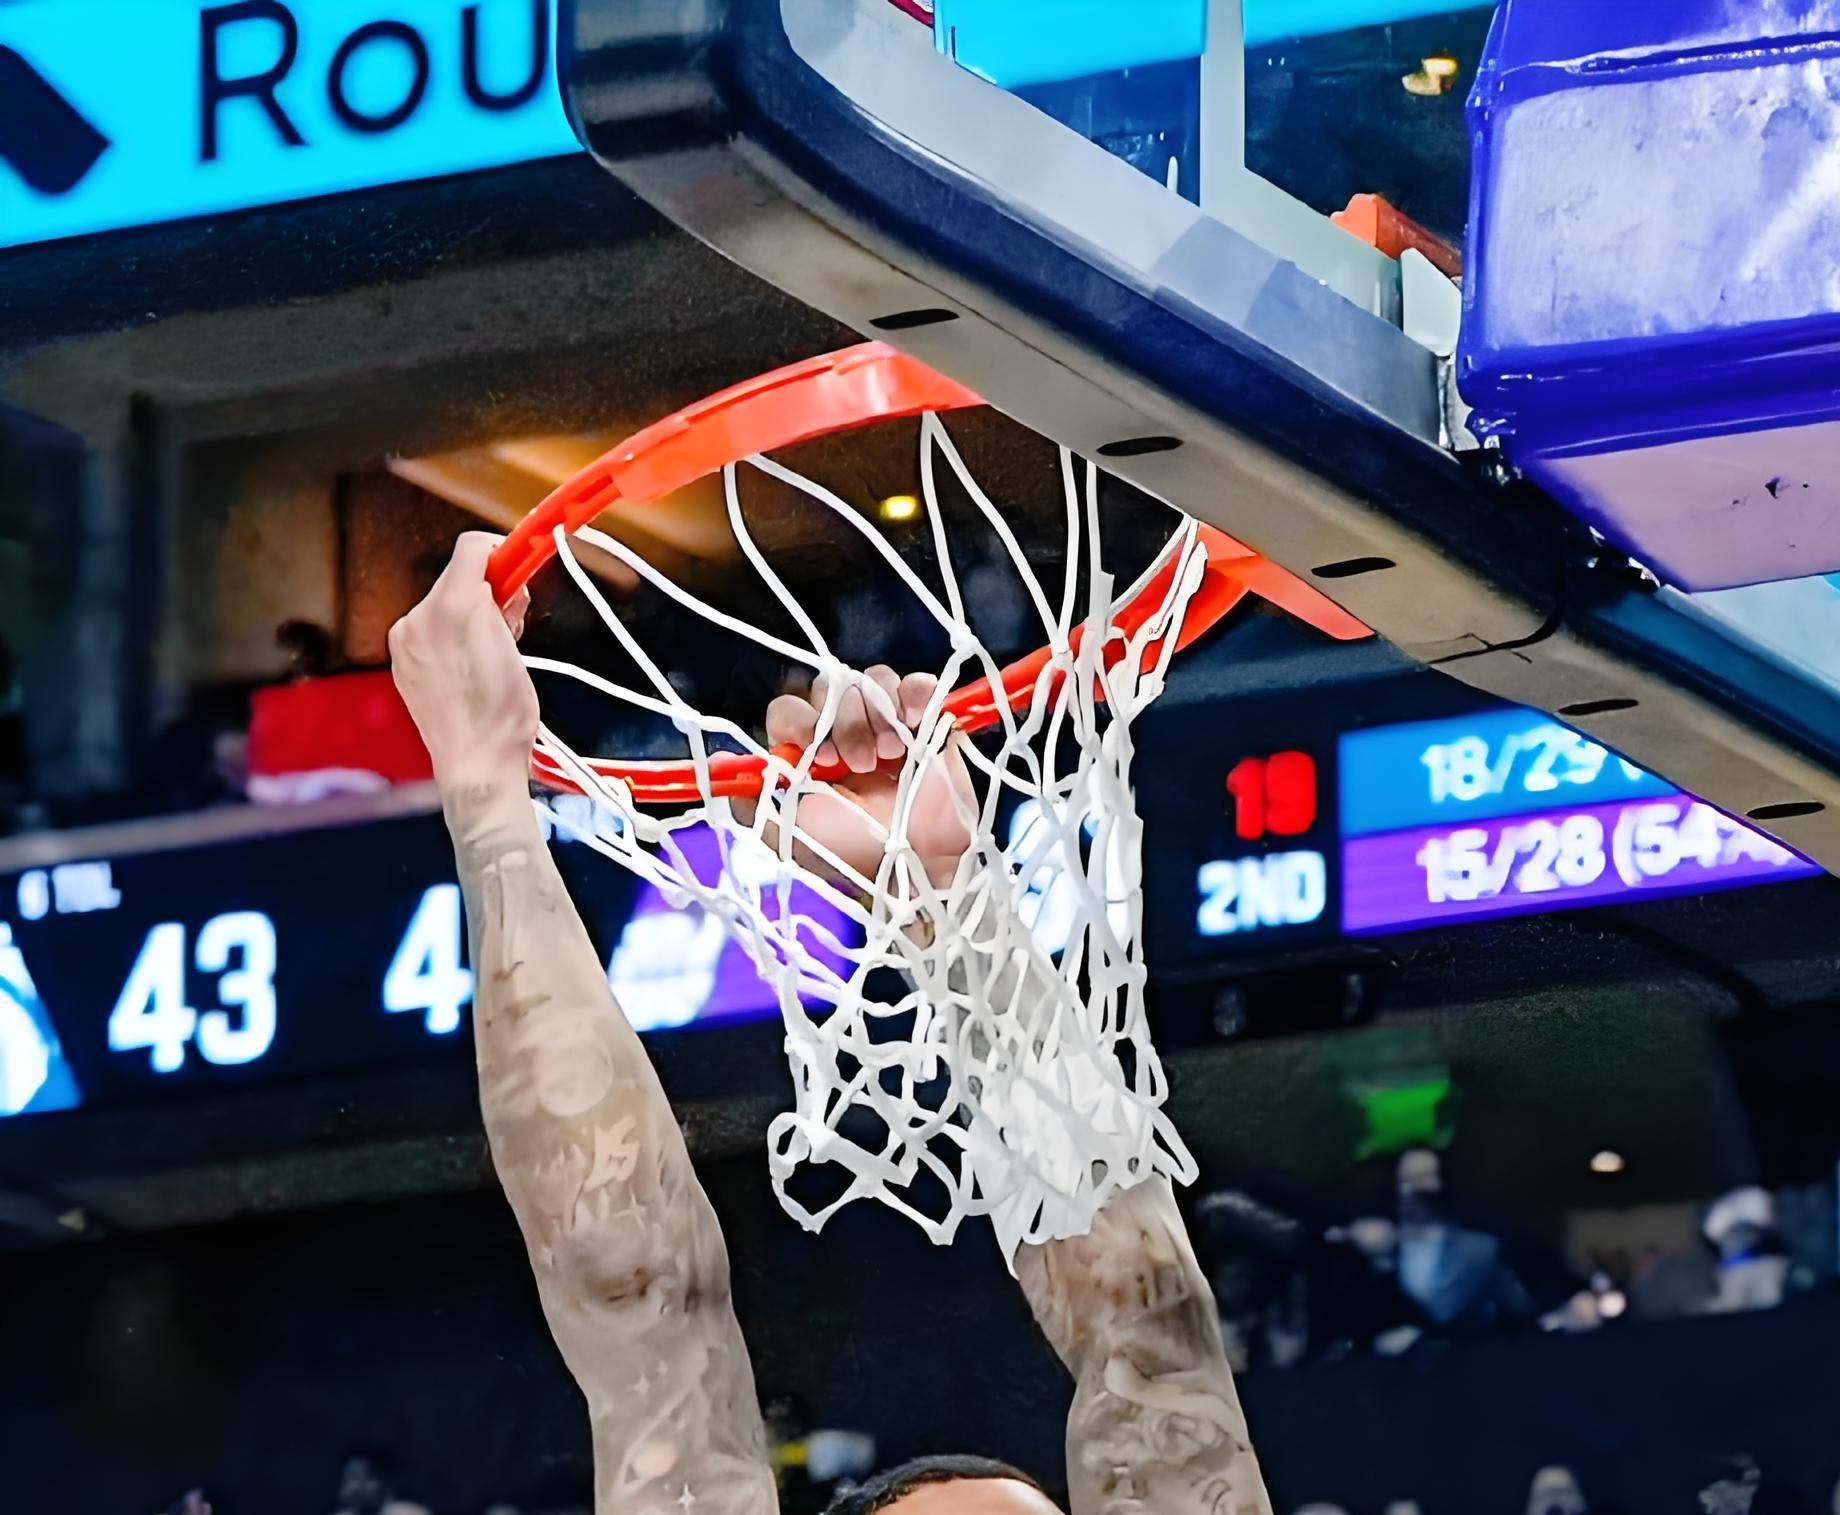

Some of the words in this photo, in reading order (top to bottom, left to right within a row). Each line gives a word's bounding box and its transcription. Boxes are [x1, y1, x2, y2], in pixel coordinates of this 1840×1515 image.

[1421, 724, 1609, 803] 18/29
[1197, 850, 1327, 936] 2ND
[1416, 815, 1607, 903] 15/28
[107, 910, 277, 1073] 43
[382, 882, 474, 1035] 4
